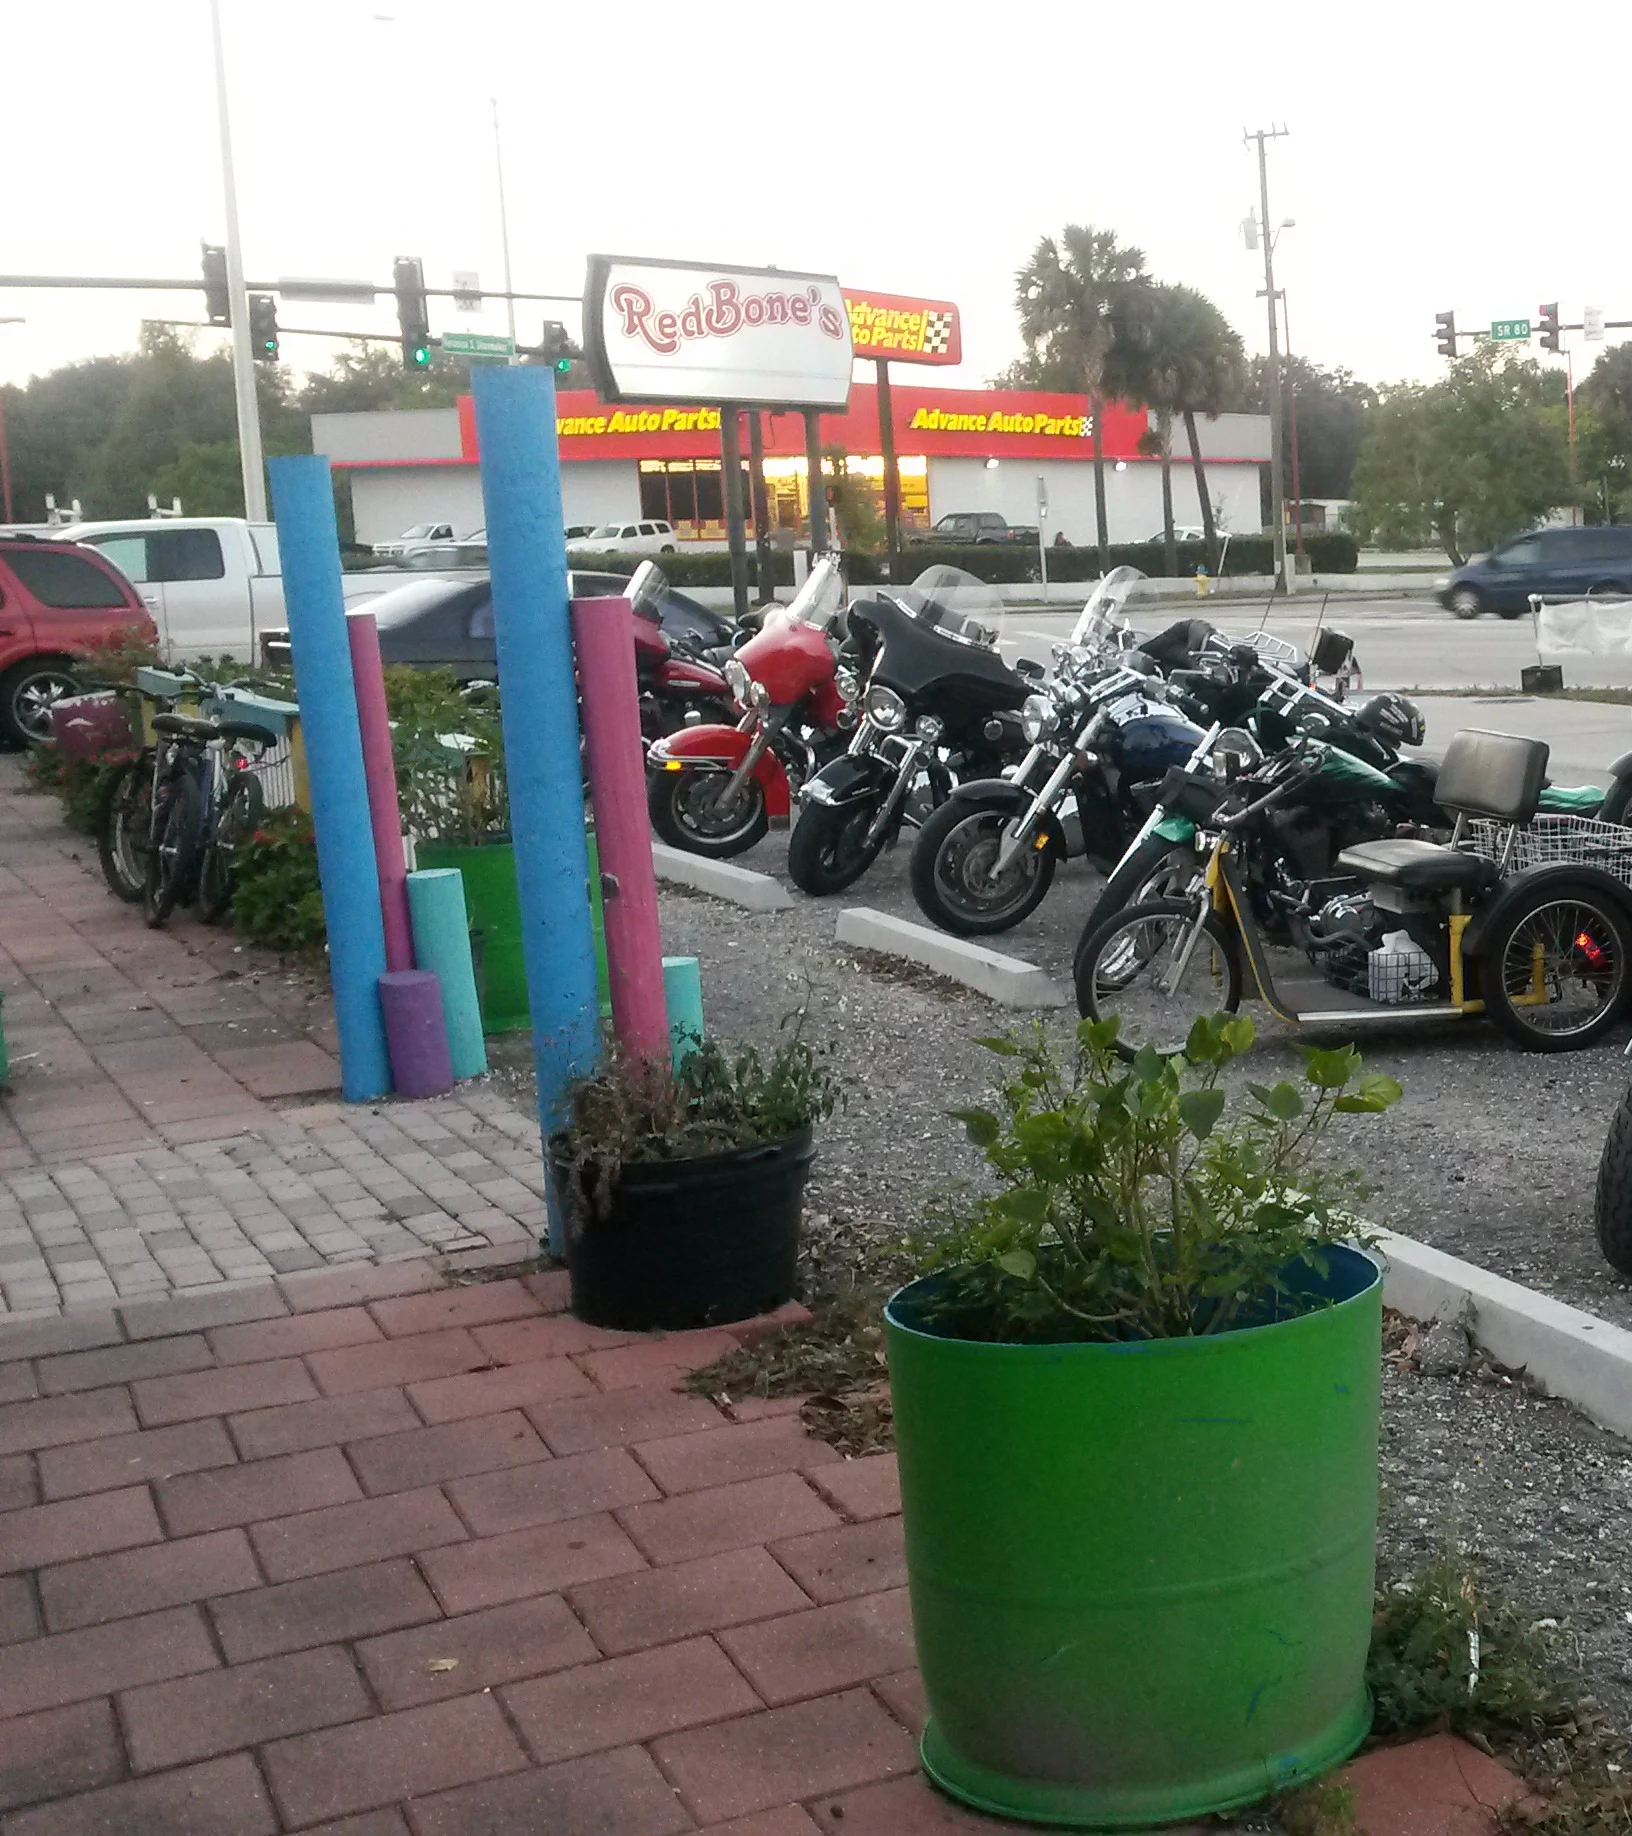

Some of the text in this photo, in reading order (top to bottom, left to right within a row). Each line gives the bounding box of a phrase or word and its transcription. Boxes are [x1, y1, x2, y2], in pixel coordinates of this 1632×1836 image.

[611, 280, 844, 355] RedBone's
[1497, 323, 1528, 337] SR 80
[871, 326, 918, 351] Parts
[556, 407, 717, 435] vance Auto Parts
[911, 408, 1079, 436] Advance Auto Parts
